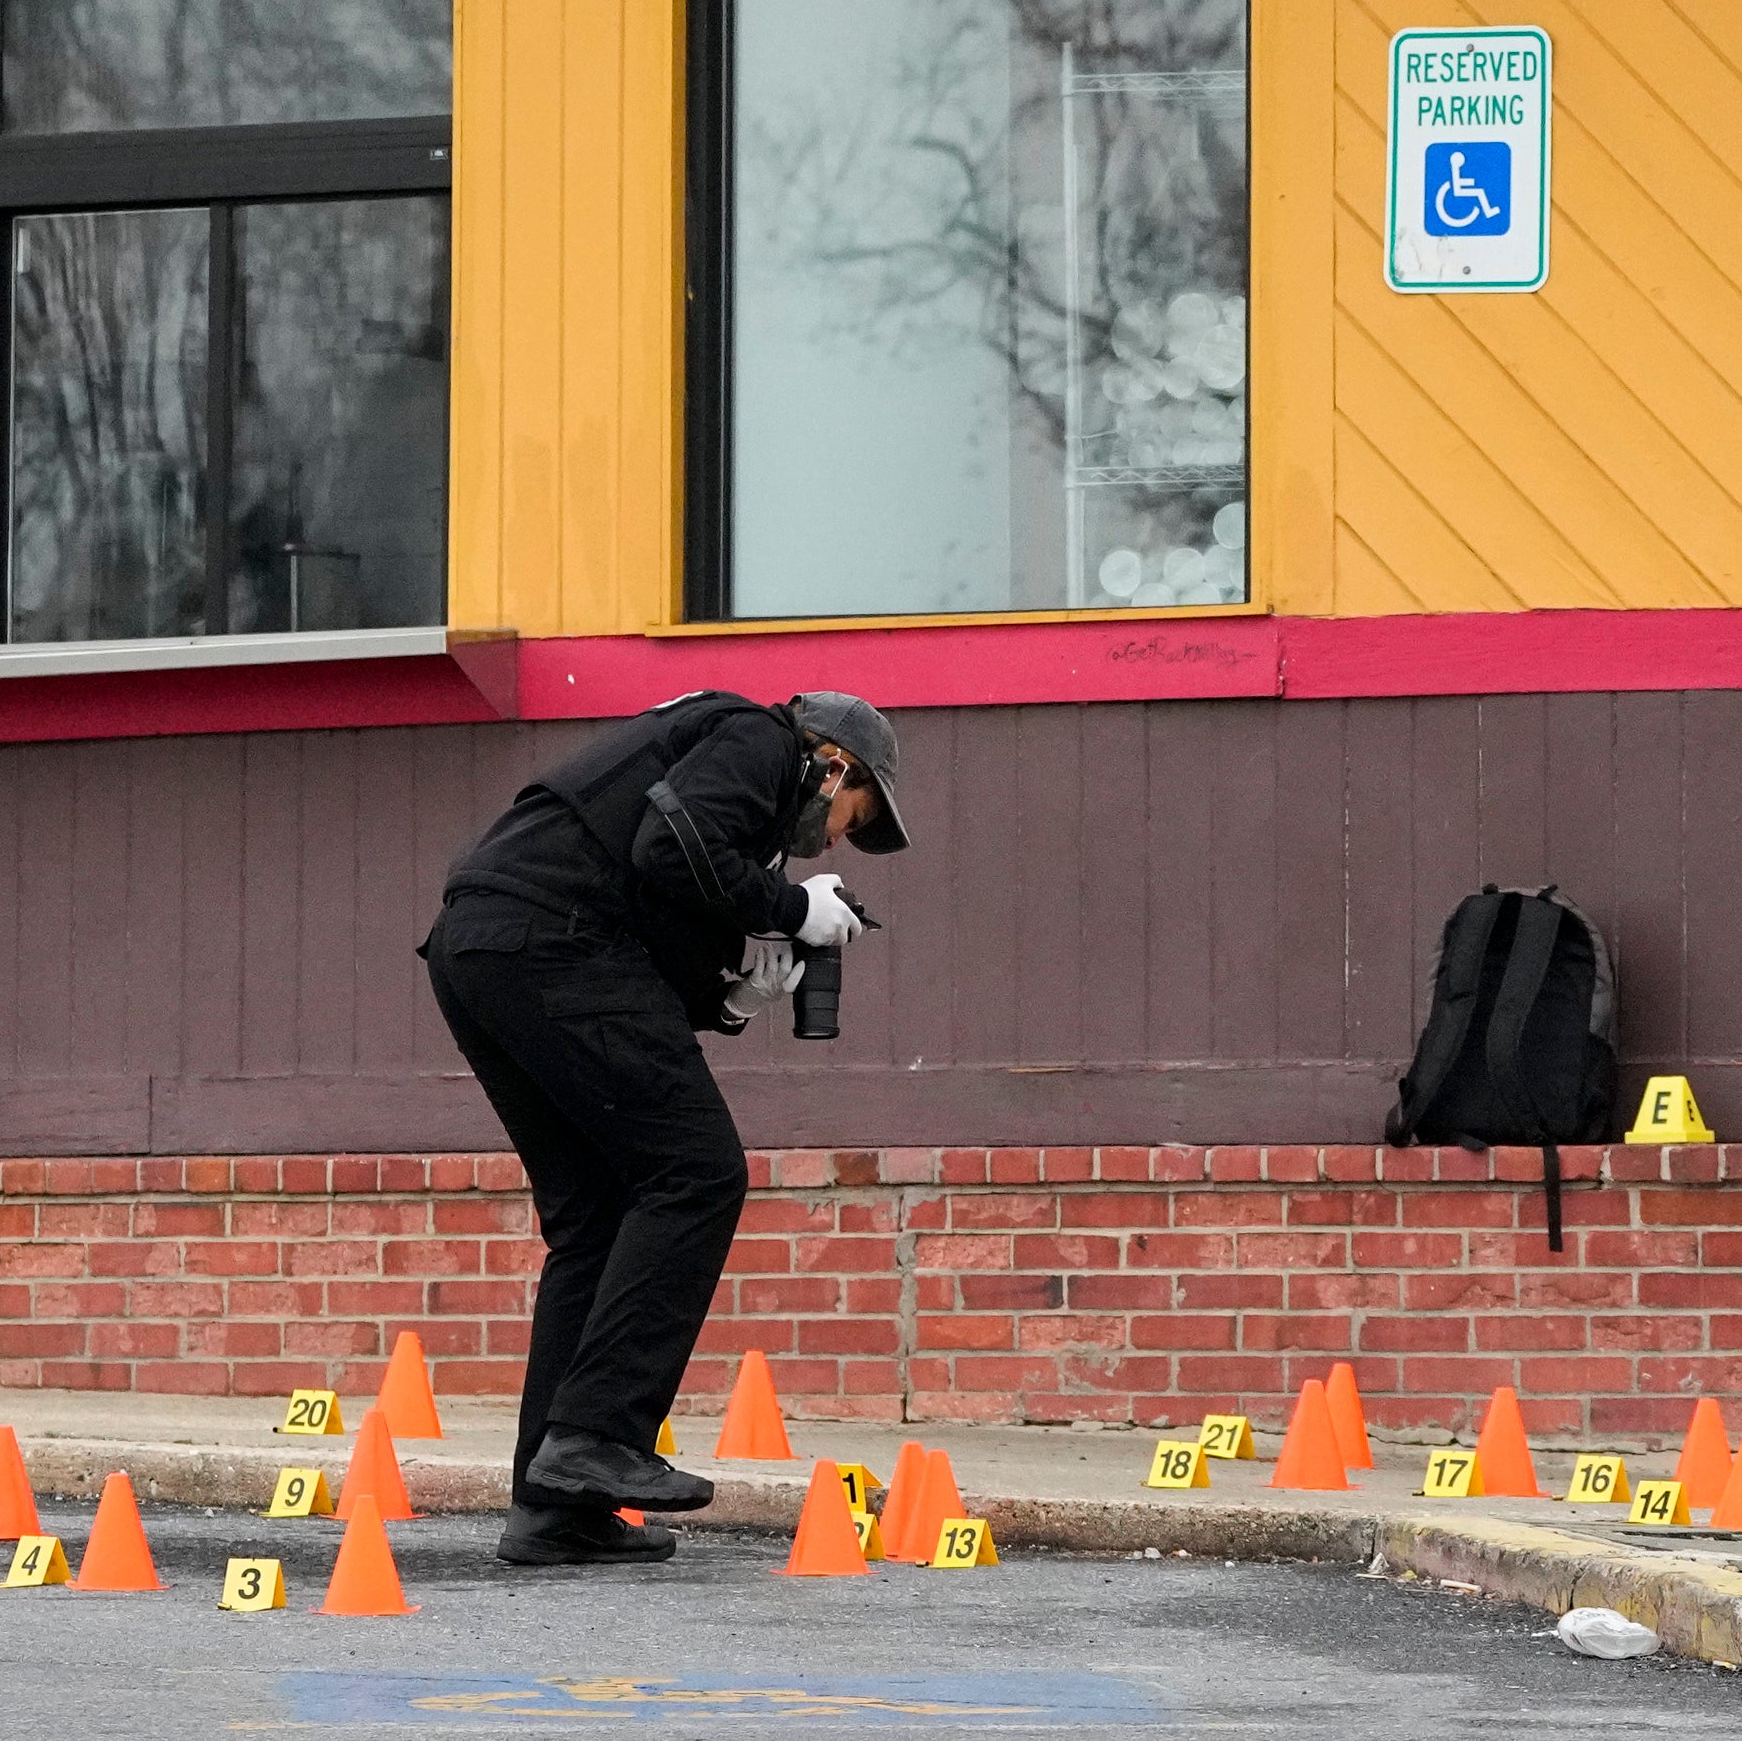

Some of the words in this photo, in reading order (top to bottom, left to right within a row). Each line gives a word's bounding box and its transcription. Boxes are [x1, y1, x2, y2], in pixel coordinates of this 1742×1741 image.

[1407, 51, 1537, 83] RESERVED
[1418, 95, 1524, 126] PARKING
[1653, 1091, 1671, 1124] E
[287, 1398, 328, 1428] 20
[1204, 1424, 1240, 1451] 21
[1159, 1450, 1190, 1479] 18
[1434, 1459, 1469, 1488] 17
[1580, 1464, 1610, 1493] 16
[284, 1478, 305, 1507] 9
[842, 1473, 856, 1503] 1
[1640, 1490, 1671, 1520] 14
[946, 1528, 976, 1558] 13
[21, 1545, 40, 1576] 4
[238, 1567, 261, 1599] 3
